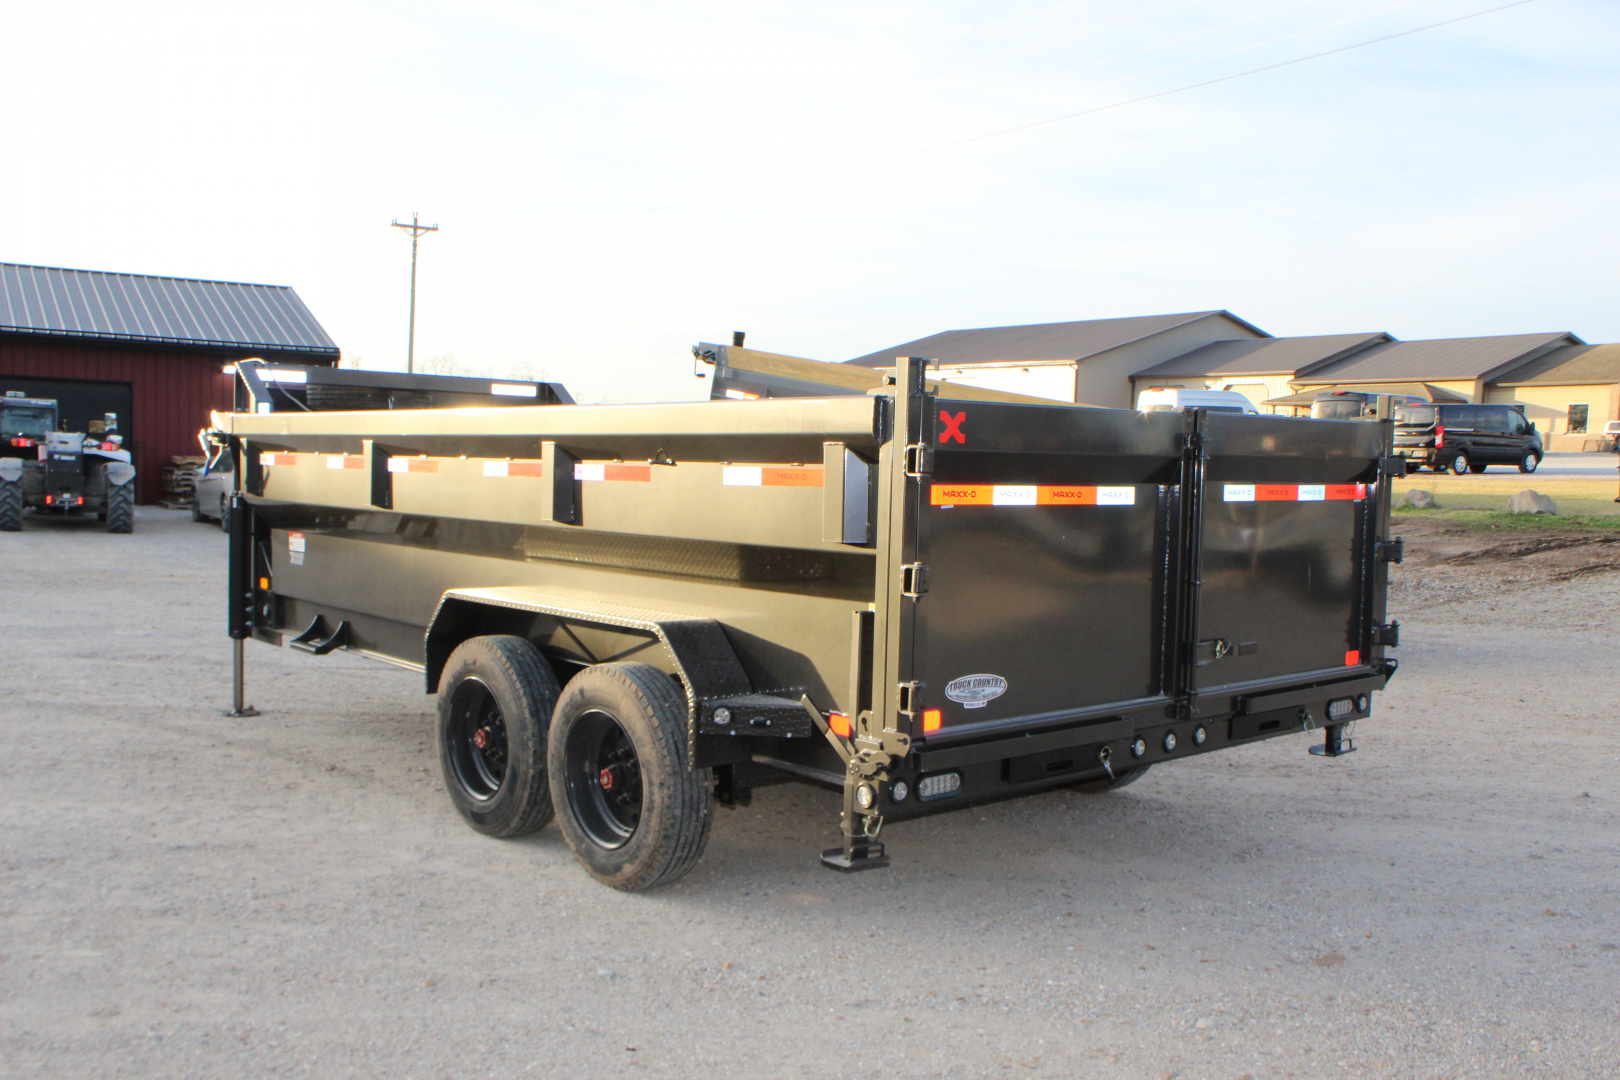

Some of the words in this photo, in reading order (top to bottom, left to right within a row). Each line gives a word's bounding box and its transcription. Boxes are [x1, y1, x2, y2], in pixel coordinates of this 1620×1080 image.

[942, 490, 977, 499] MAXX-D
[1052, 491, 1083, 499] MAXX-D
[950, 679, 972, 692] TRUCK
[972, 677, 1004, 688] COUNTRY
